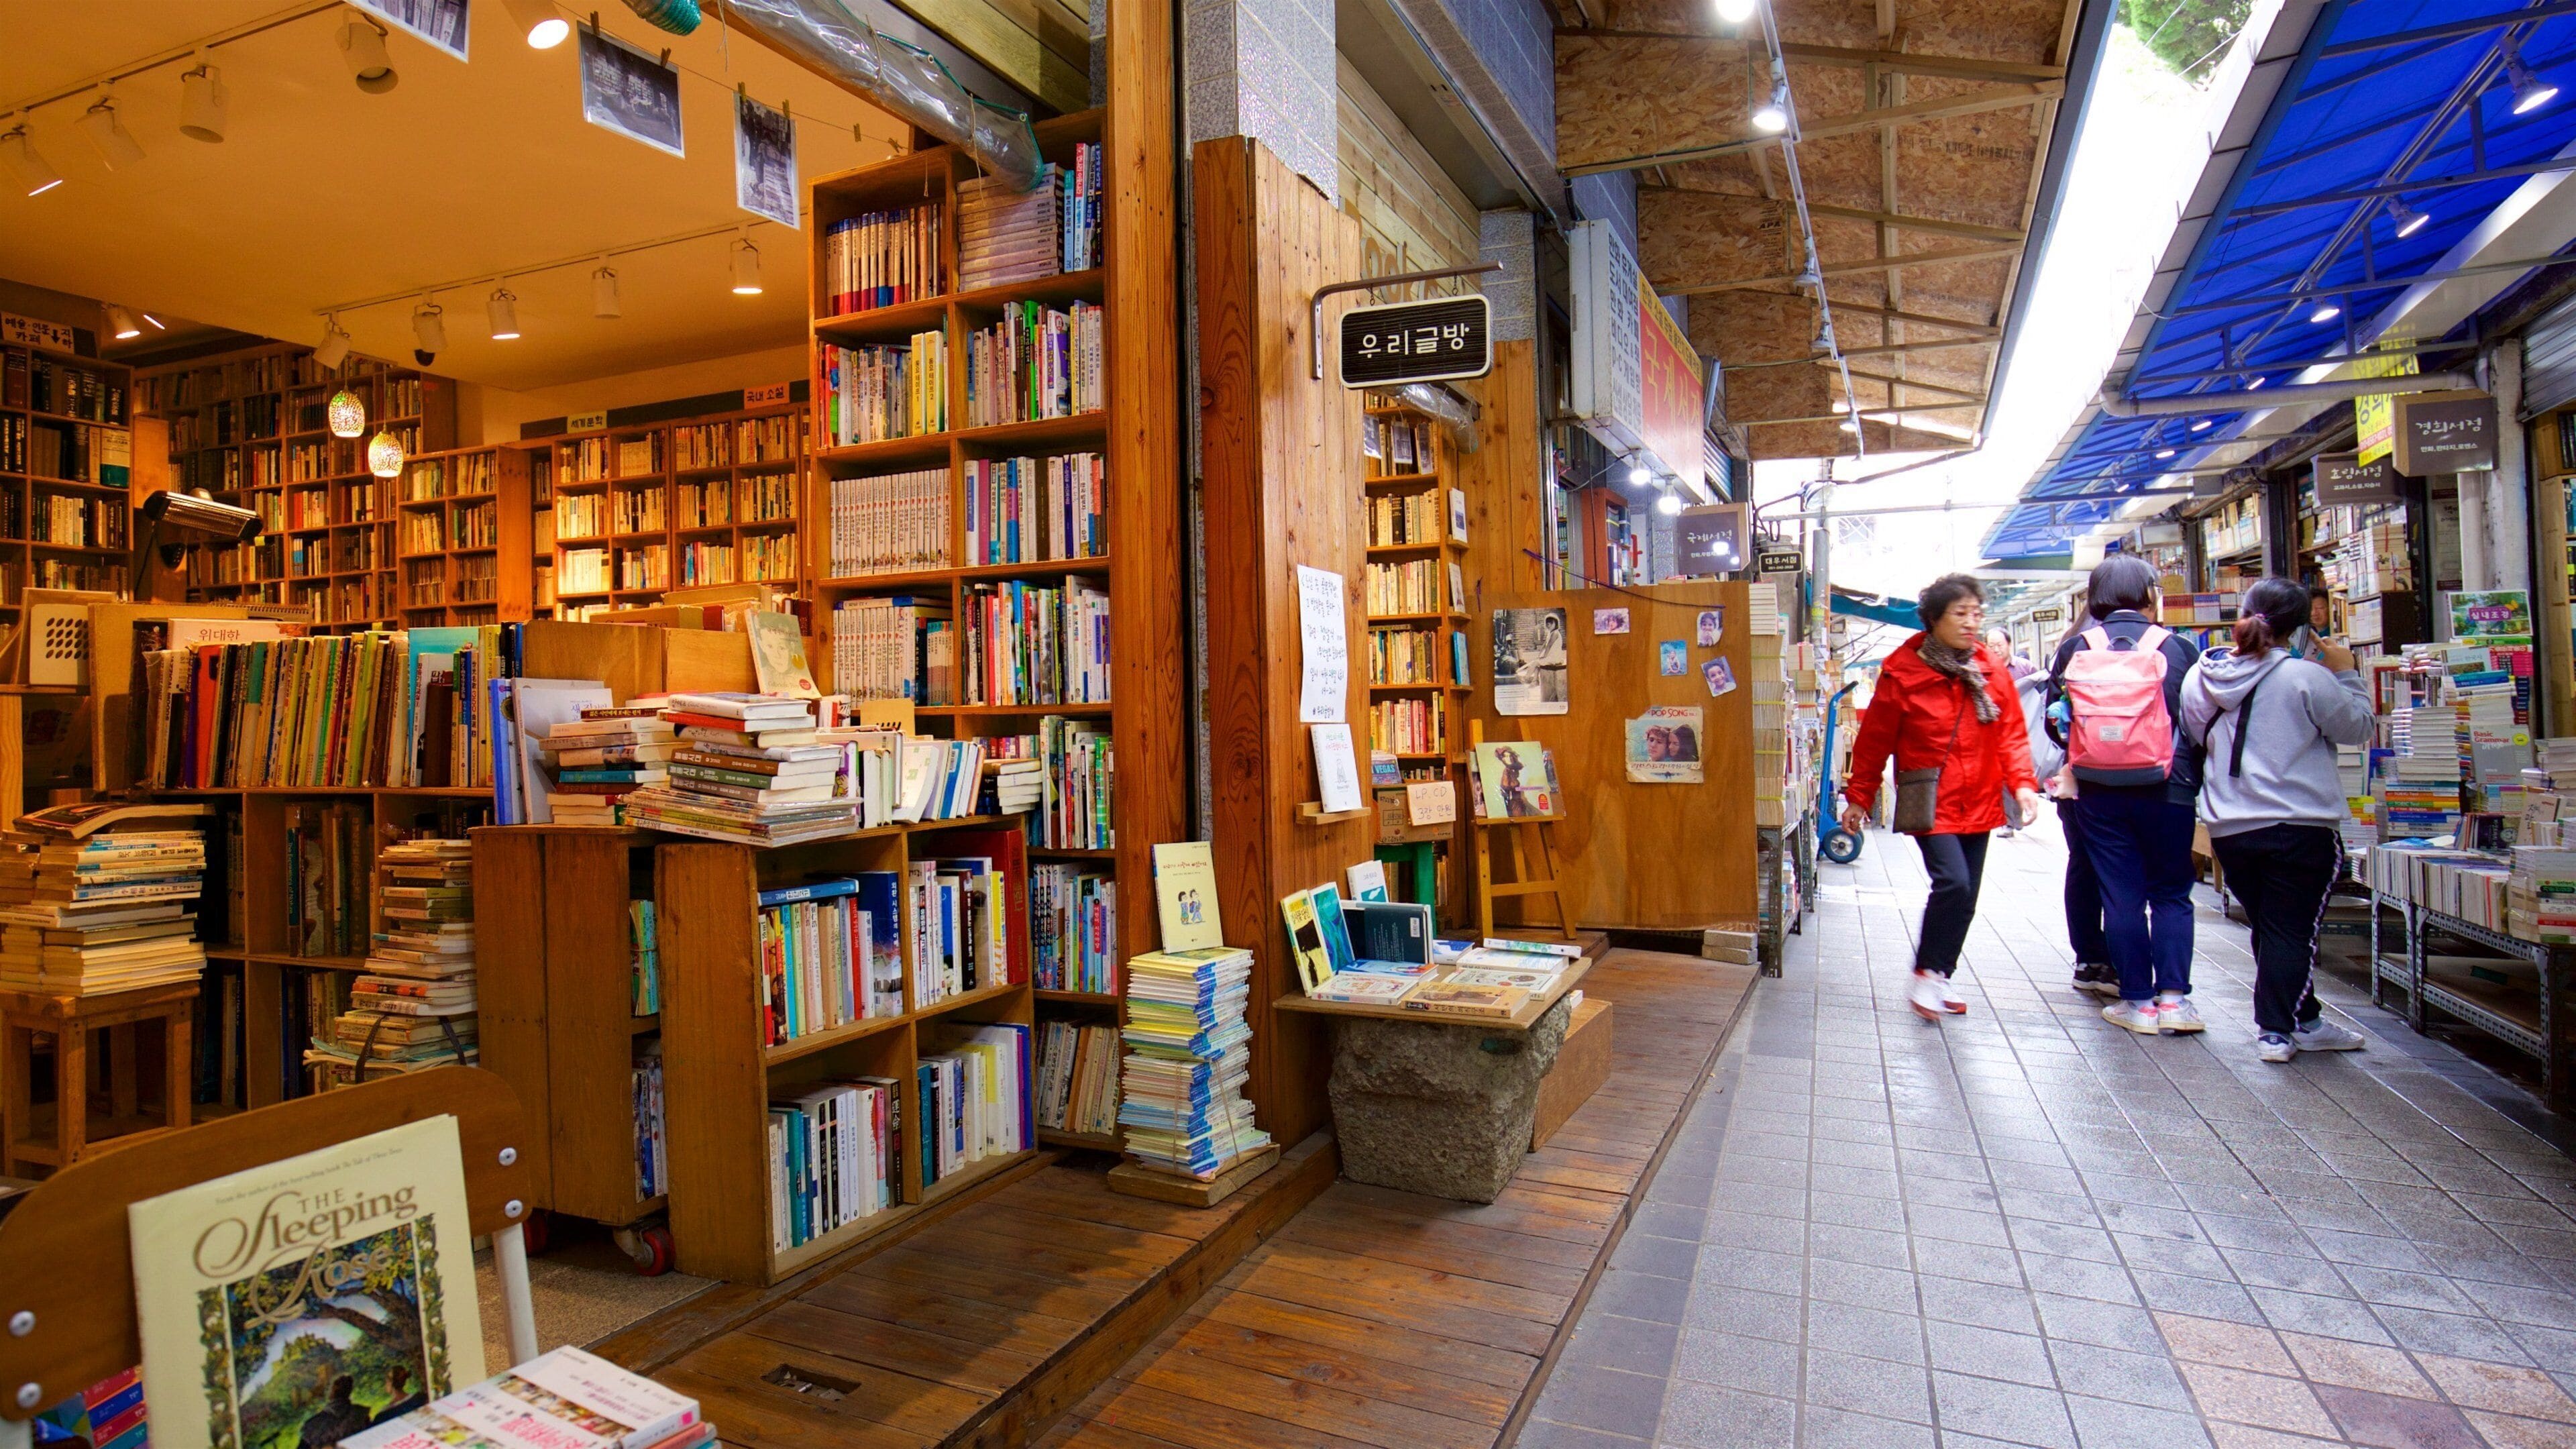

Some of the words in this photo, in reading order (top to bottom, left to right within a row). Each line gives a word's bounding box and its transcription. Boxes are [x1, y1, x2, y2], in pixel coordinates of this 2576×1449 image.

[1608, 231, 1620, 268] 만화
[1621, 251, 1638, 292] 휴게실
[1609, 258, 1621, 296] 도서
[1622, 277, 1638, 318] 대여점
[1609, 287, 1623, 324] 만화
[1627, 309, 1639, 343] 카페
[16, 331, 41, 345] 카페
[1358, 323, 1469, 359] 우리글방
[1611, 315, 1629, 356] 비디오
[1623, 358, 1641, 396] 게임방
[747, 390, 763, 402] 국내
[767, 386, 784, 400] 소설
[2359, 394, 2391, 425] 경희
[571, 415, 603, 429] 세계문학
[2416, 417, 2481, 435] 경희서점
[2420, 442, 2478, 453] 만화,판타지,로맨스
[2330, 466, 2381, 480] 효림서점
[1765, 556, 1796, 565] 대우서점
[2469, 610, 2510, 621] 실내조경
[1651, 709, 1667, 717] POP
[1668, 708, 1688, 717] SONG
[1375, 763, 1396, 772] VEGAS
[1434, 786, 1447, 798] CD
[1417, 807, 1433, 820] 3장
[248, 1186, 270, 1197] author
[298, 1186, 346, 1210] THE
[193, 1185, 419, 1278] Sleeping
[244, 1240, 402, 1330] Rose
